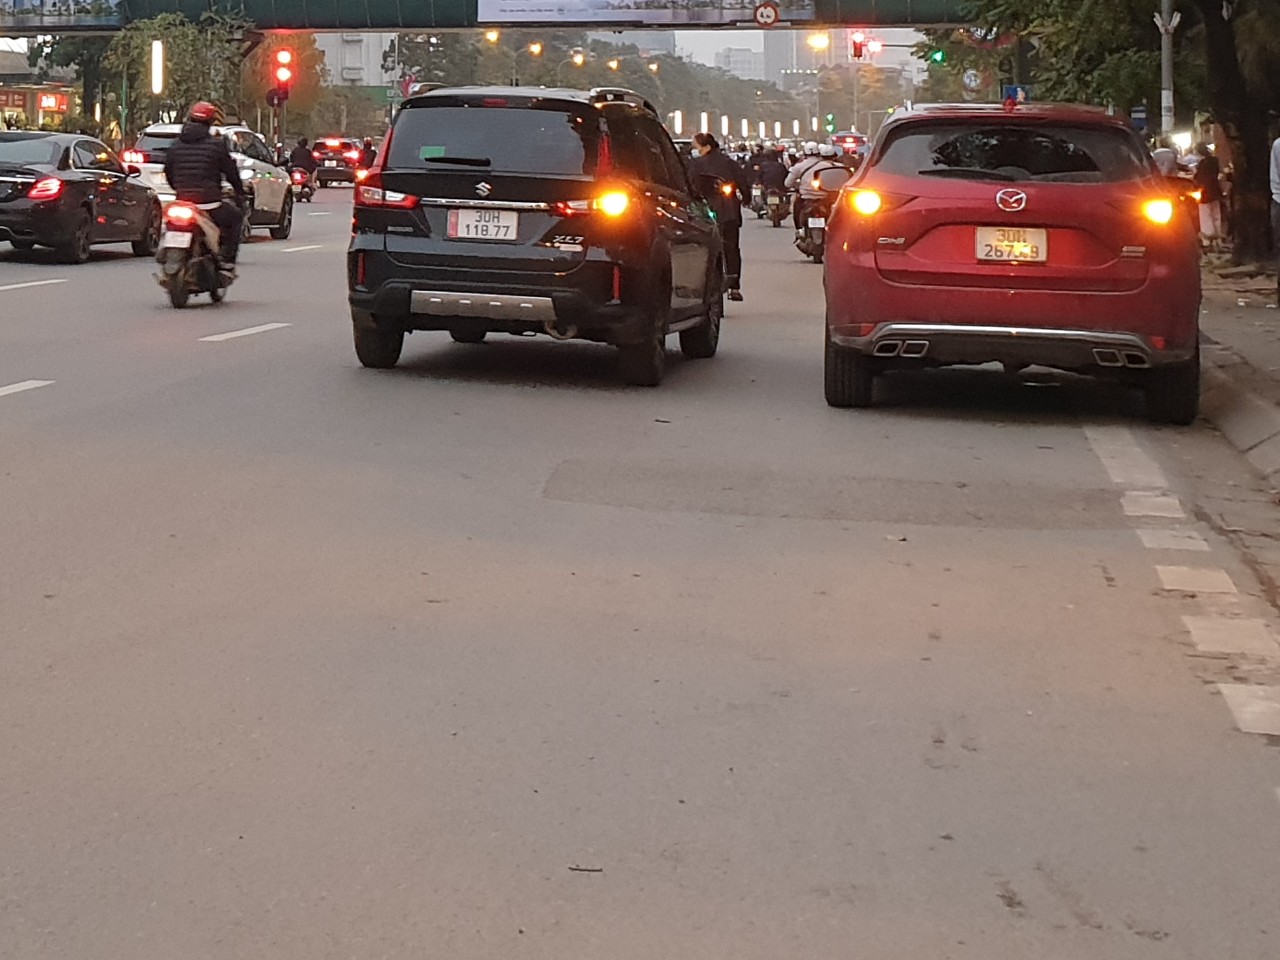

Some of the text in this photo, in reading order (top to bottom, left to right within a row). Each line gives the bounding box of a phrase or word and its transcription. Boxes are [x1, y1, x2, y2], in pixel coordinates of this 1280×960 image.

[475, 210, 500, 223] 30H
[465, 223, 510, 237] 118.77
[552, 235, 585, 244] XL7
